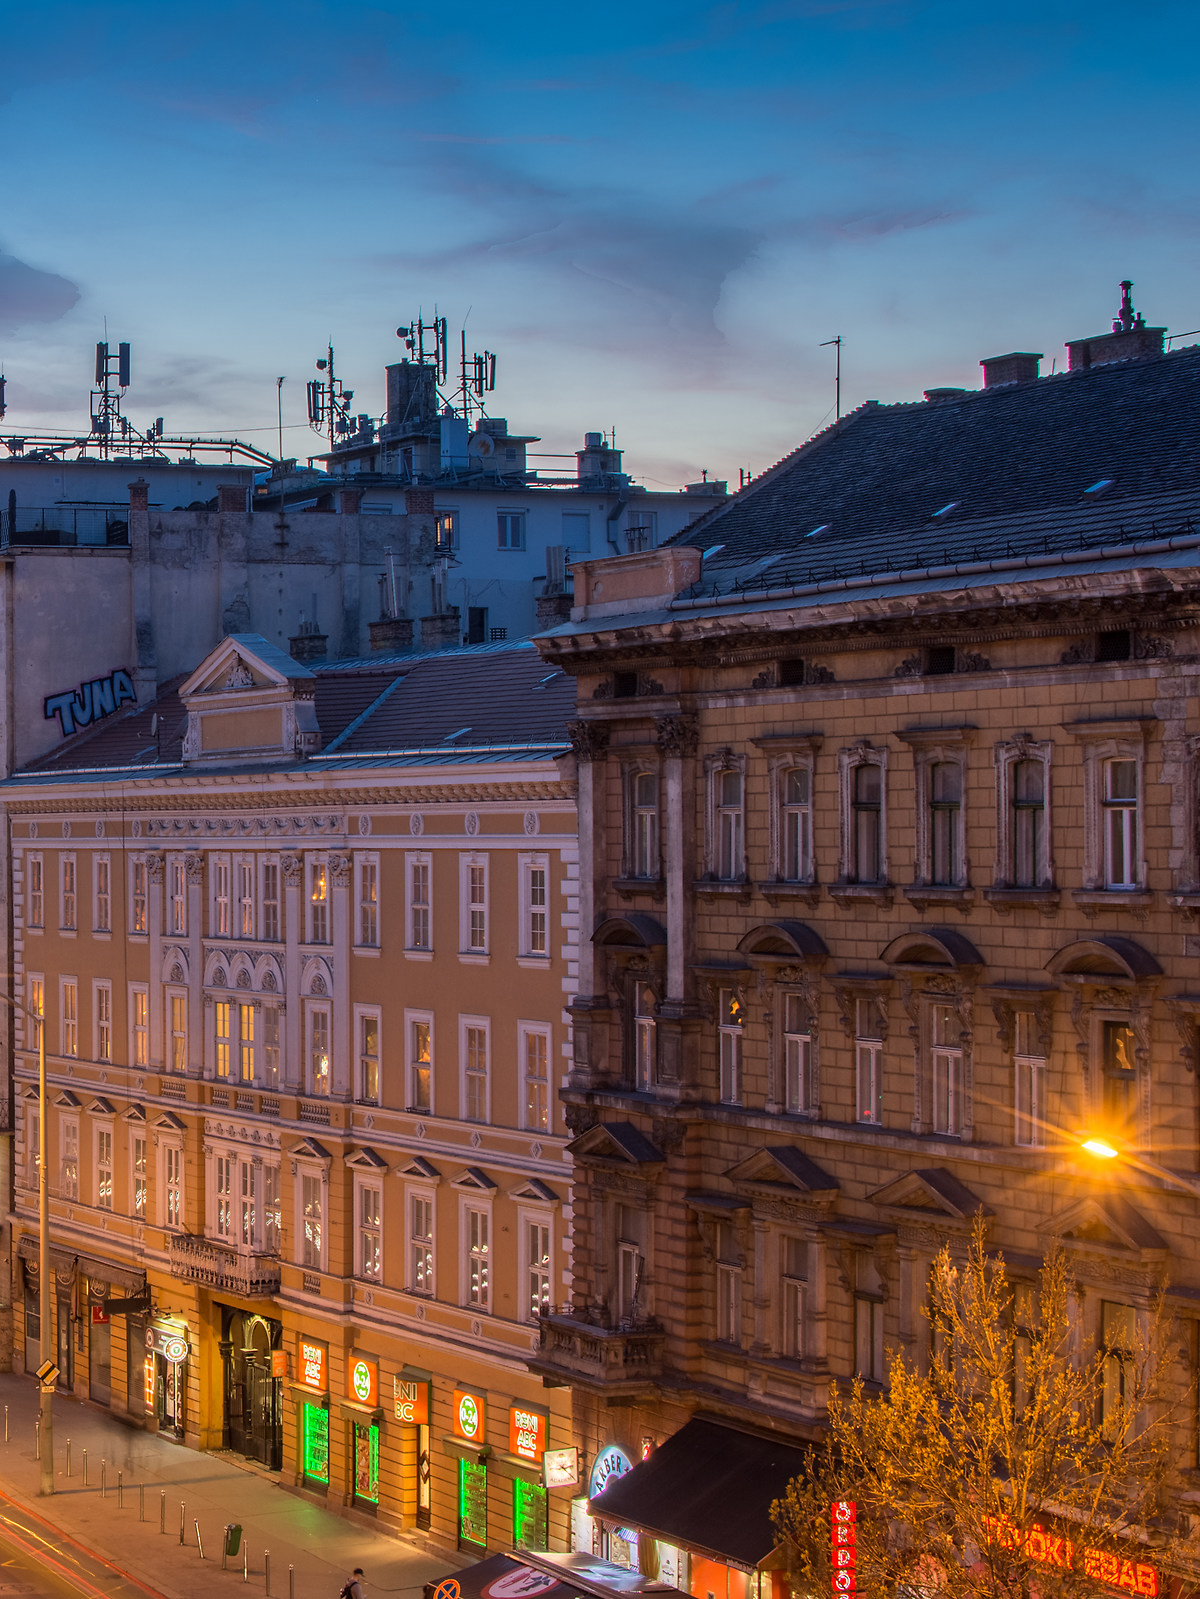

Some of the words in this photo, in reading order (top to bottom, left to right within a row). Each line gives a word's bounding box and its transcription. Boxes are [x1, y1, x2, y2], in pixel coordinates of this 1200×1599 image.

[43, 668, 137, 737] TUNA
[305, 1361, 320, 1379] ABC
[461, 1408, 478, 1427] 0-24
[517, 1430, 536, 1450] ABC
